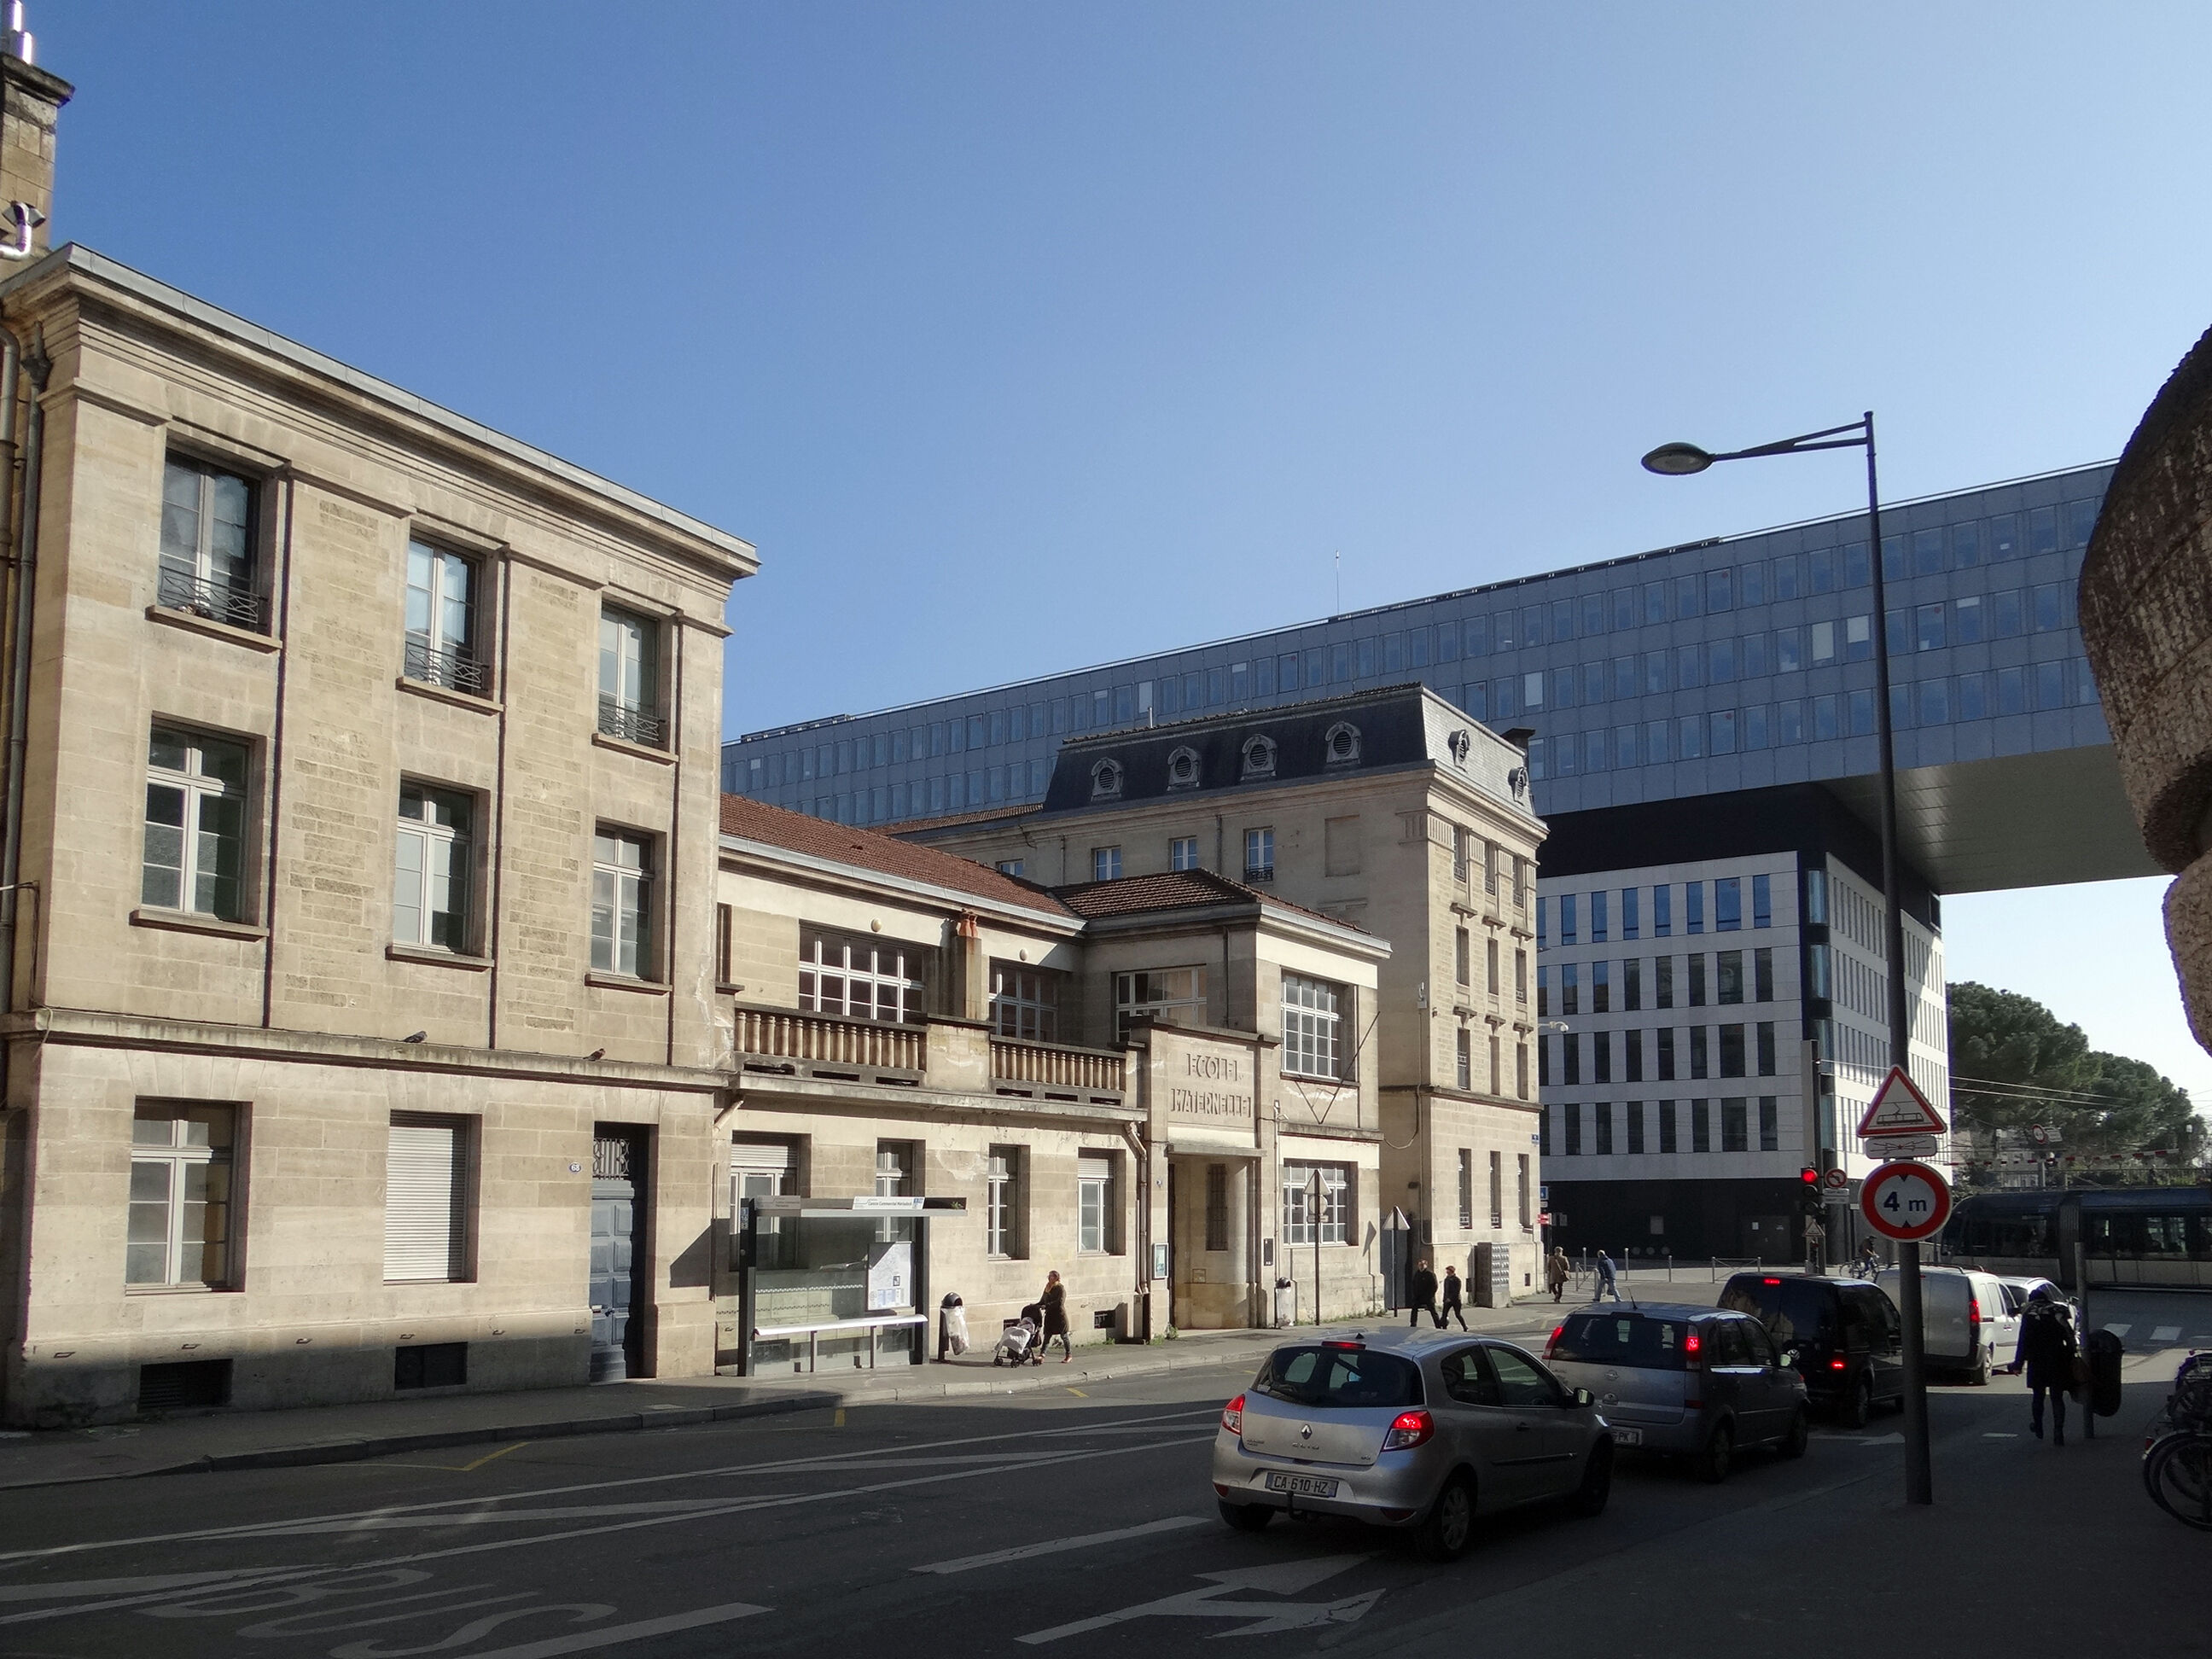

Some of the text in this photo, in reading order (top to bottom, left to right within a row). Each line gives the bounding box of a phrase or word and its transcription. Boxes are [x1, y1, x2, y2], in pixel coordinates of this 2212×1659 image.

[1171, 1088, 1251, 1118] MATERNELLE
[1883, 1191, 1927, 1212] 4 m
